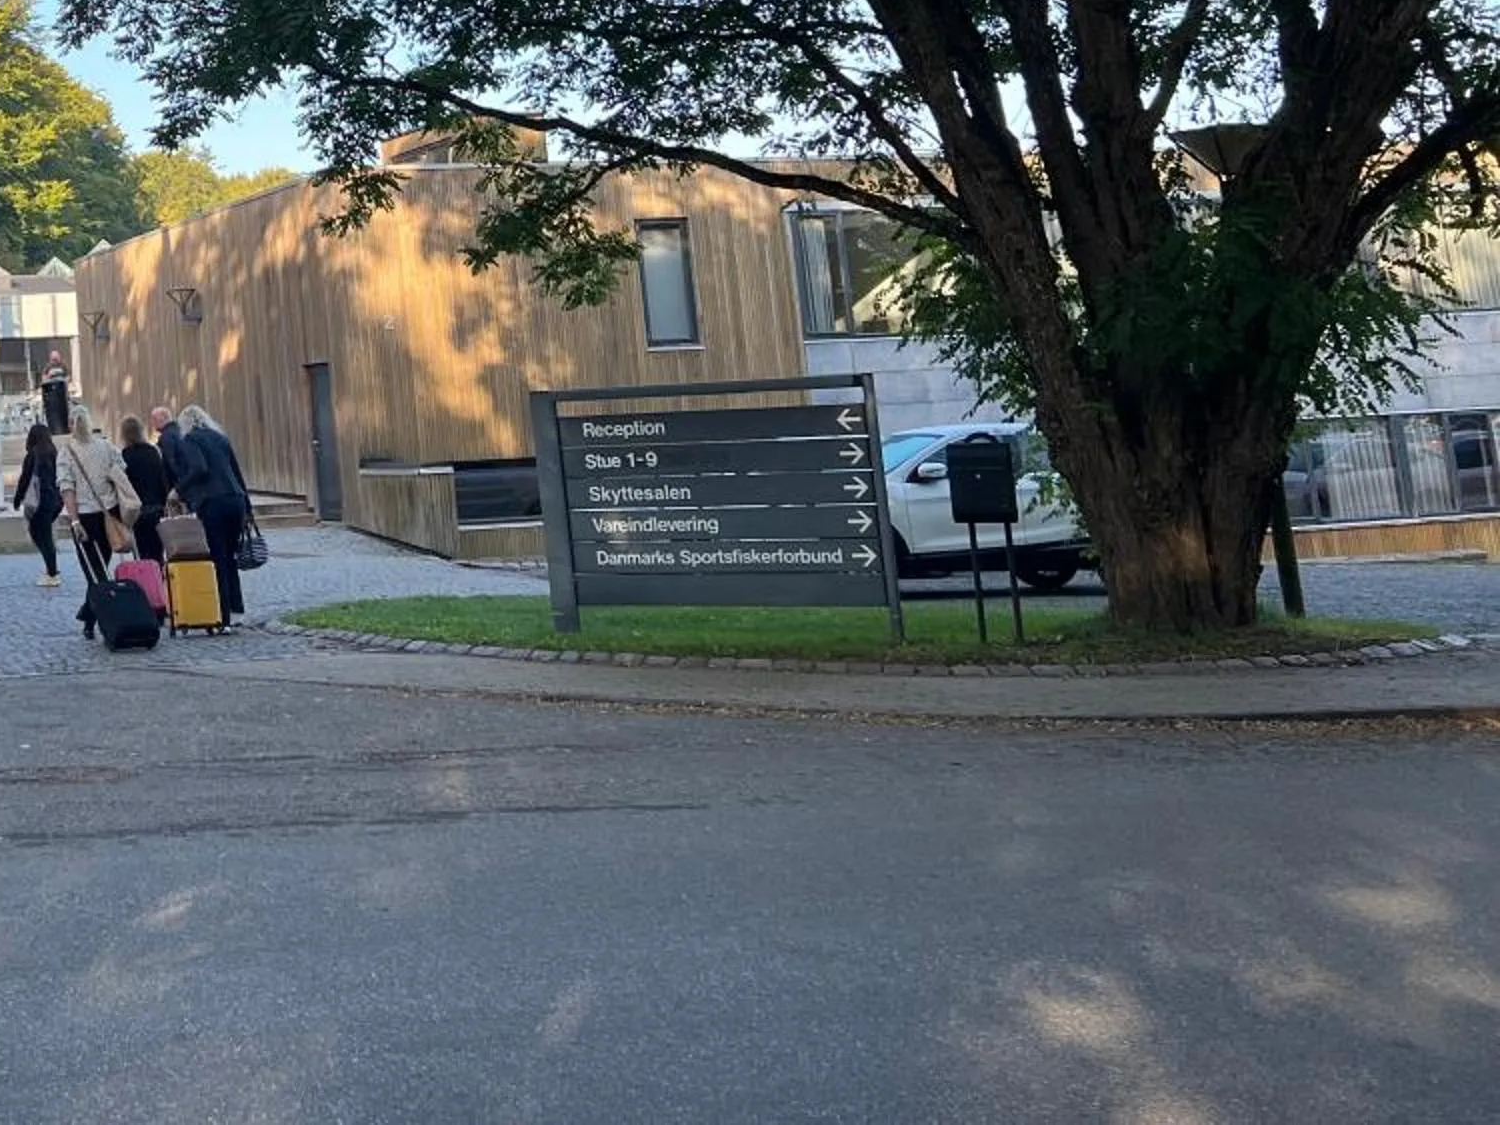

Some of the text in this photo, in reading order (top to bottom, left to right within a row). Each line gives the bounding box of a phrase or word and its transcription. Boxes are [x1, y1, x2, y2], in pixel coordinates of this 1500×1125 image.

[582, 420, 666, 439] Reception
[584, 451, 658, 469] Stue 1-9
[588, 484, 691, 505] Skyttesalen
[592, 516, 720, 534] Vareindlevering
[596, 547, 843, 568] Danmarks Sportsfiskerforbund
